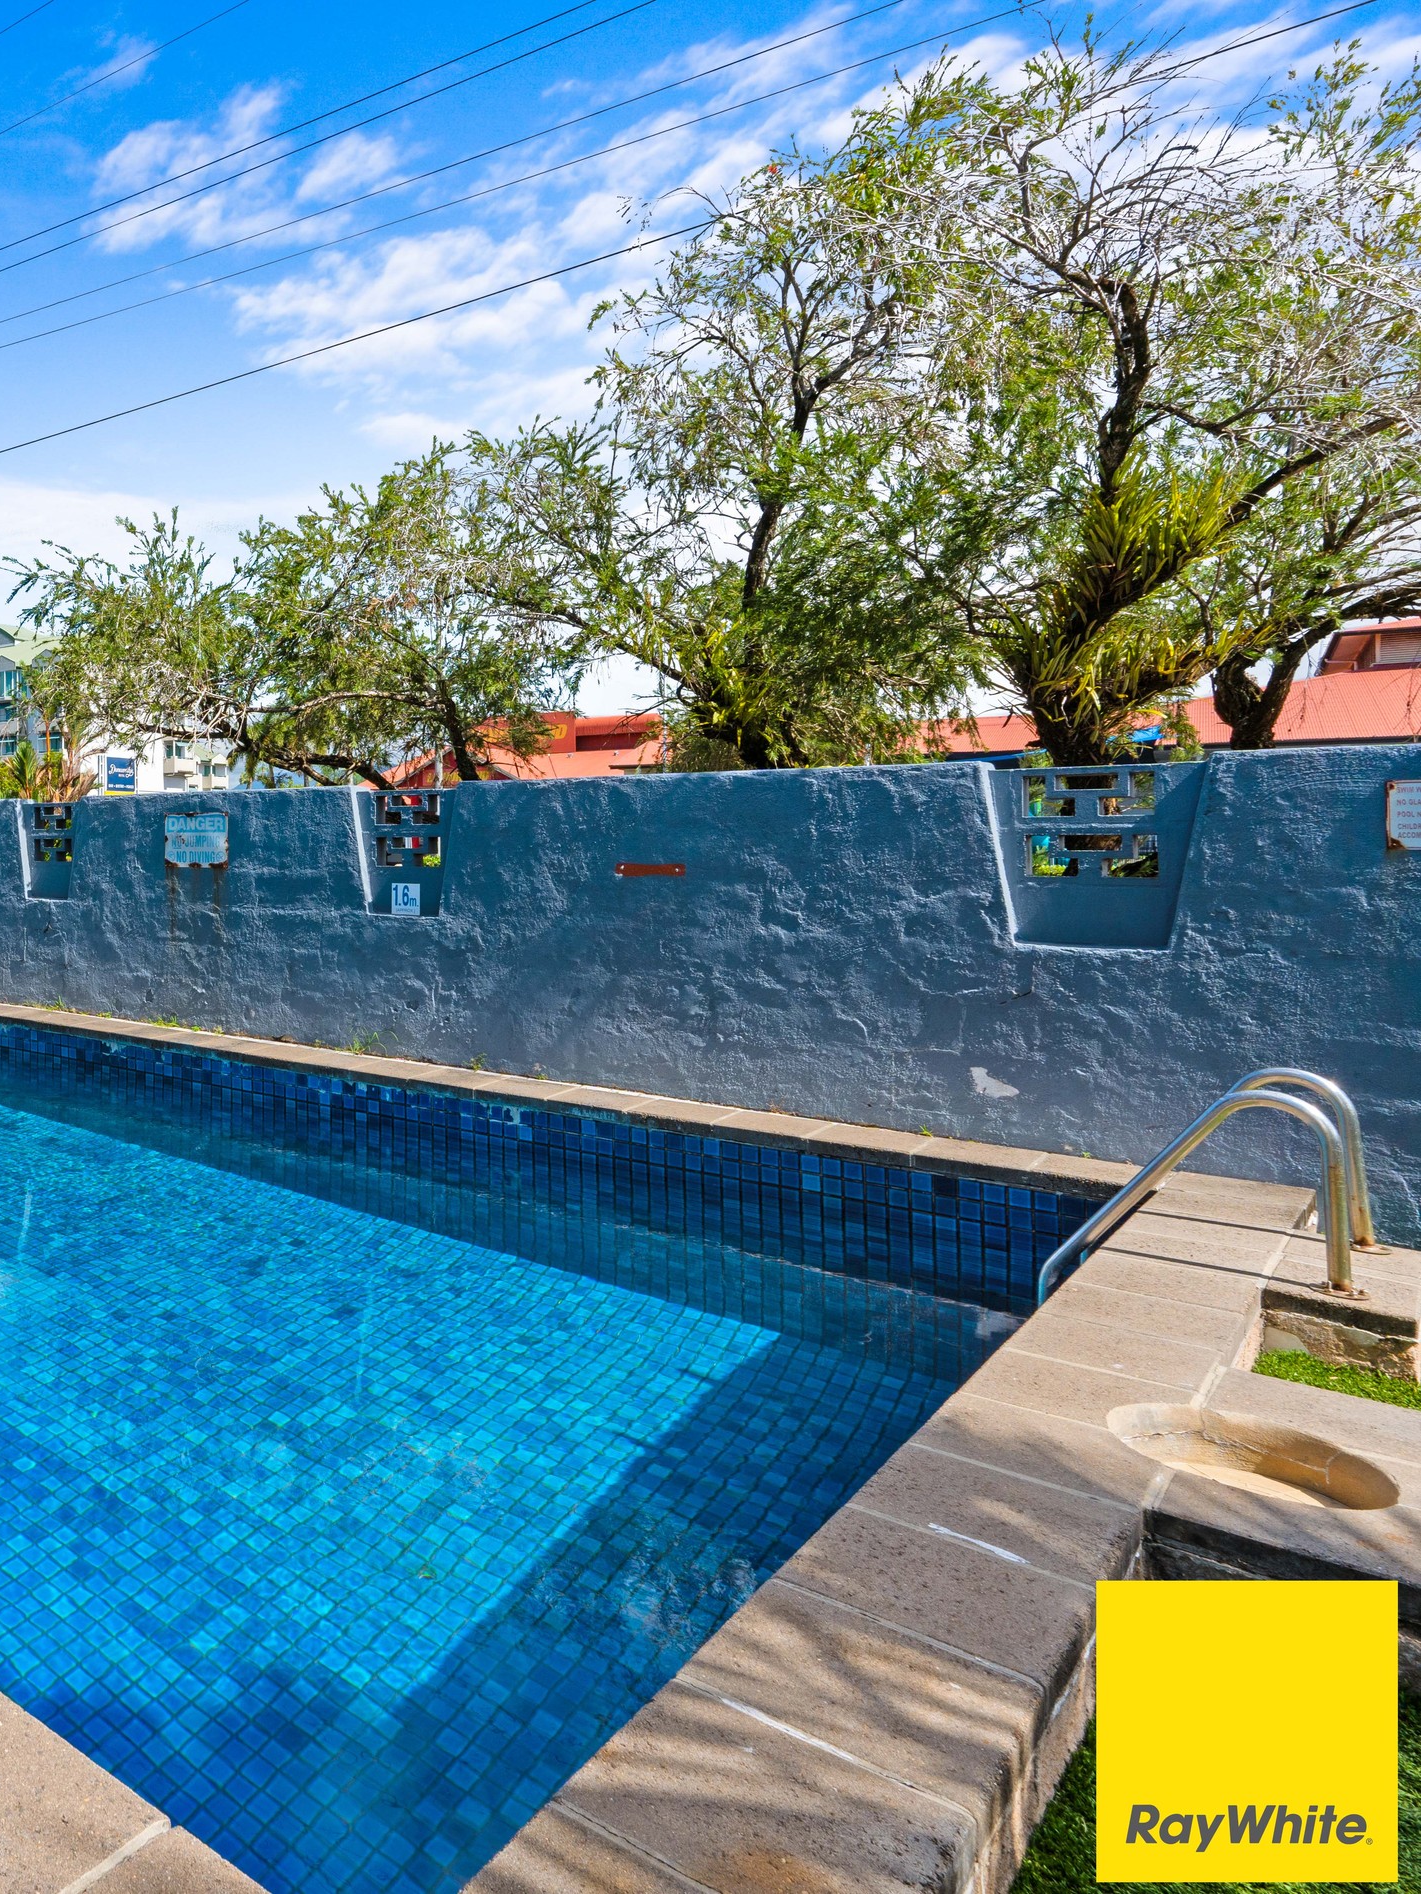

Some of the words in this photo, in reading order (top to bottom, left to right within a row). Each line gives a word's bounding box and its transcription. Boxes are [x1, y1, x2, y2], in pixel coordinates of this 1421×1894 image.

[168, 816, 224, 831] DANGER
[172, 835, 182, 848] NO
[184, 835, 220, 848] JUMPING
[176, 850, 187, 863] NO
[189, 850, 215, 863] DIVING
